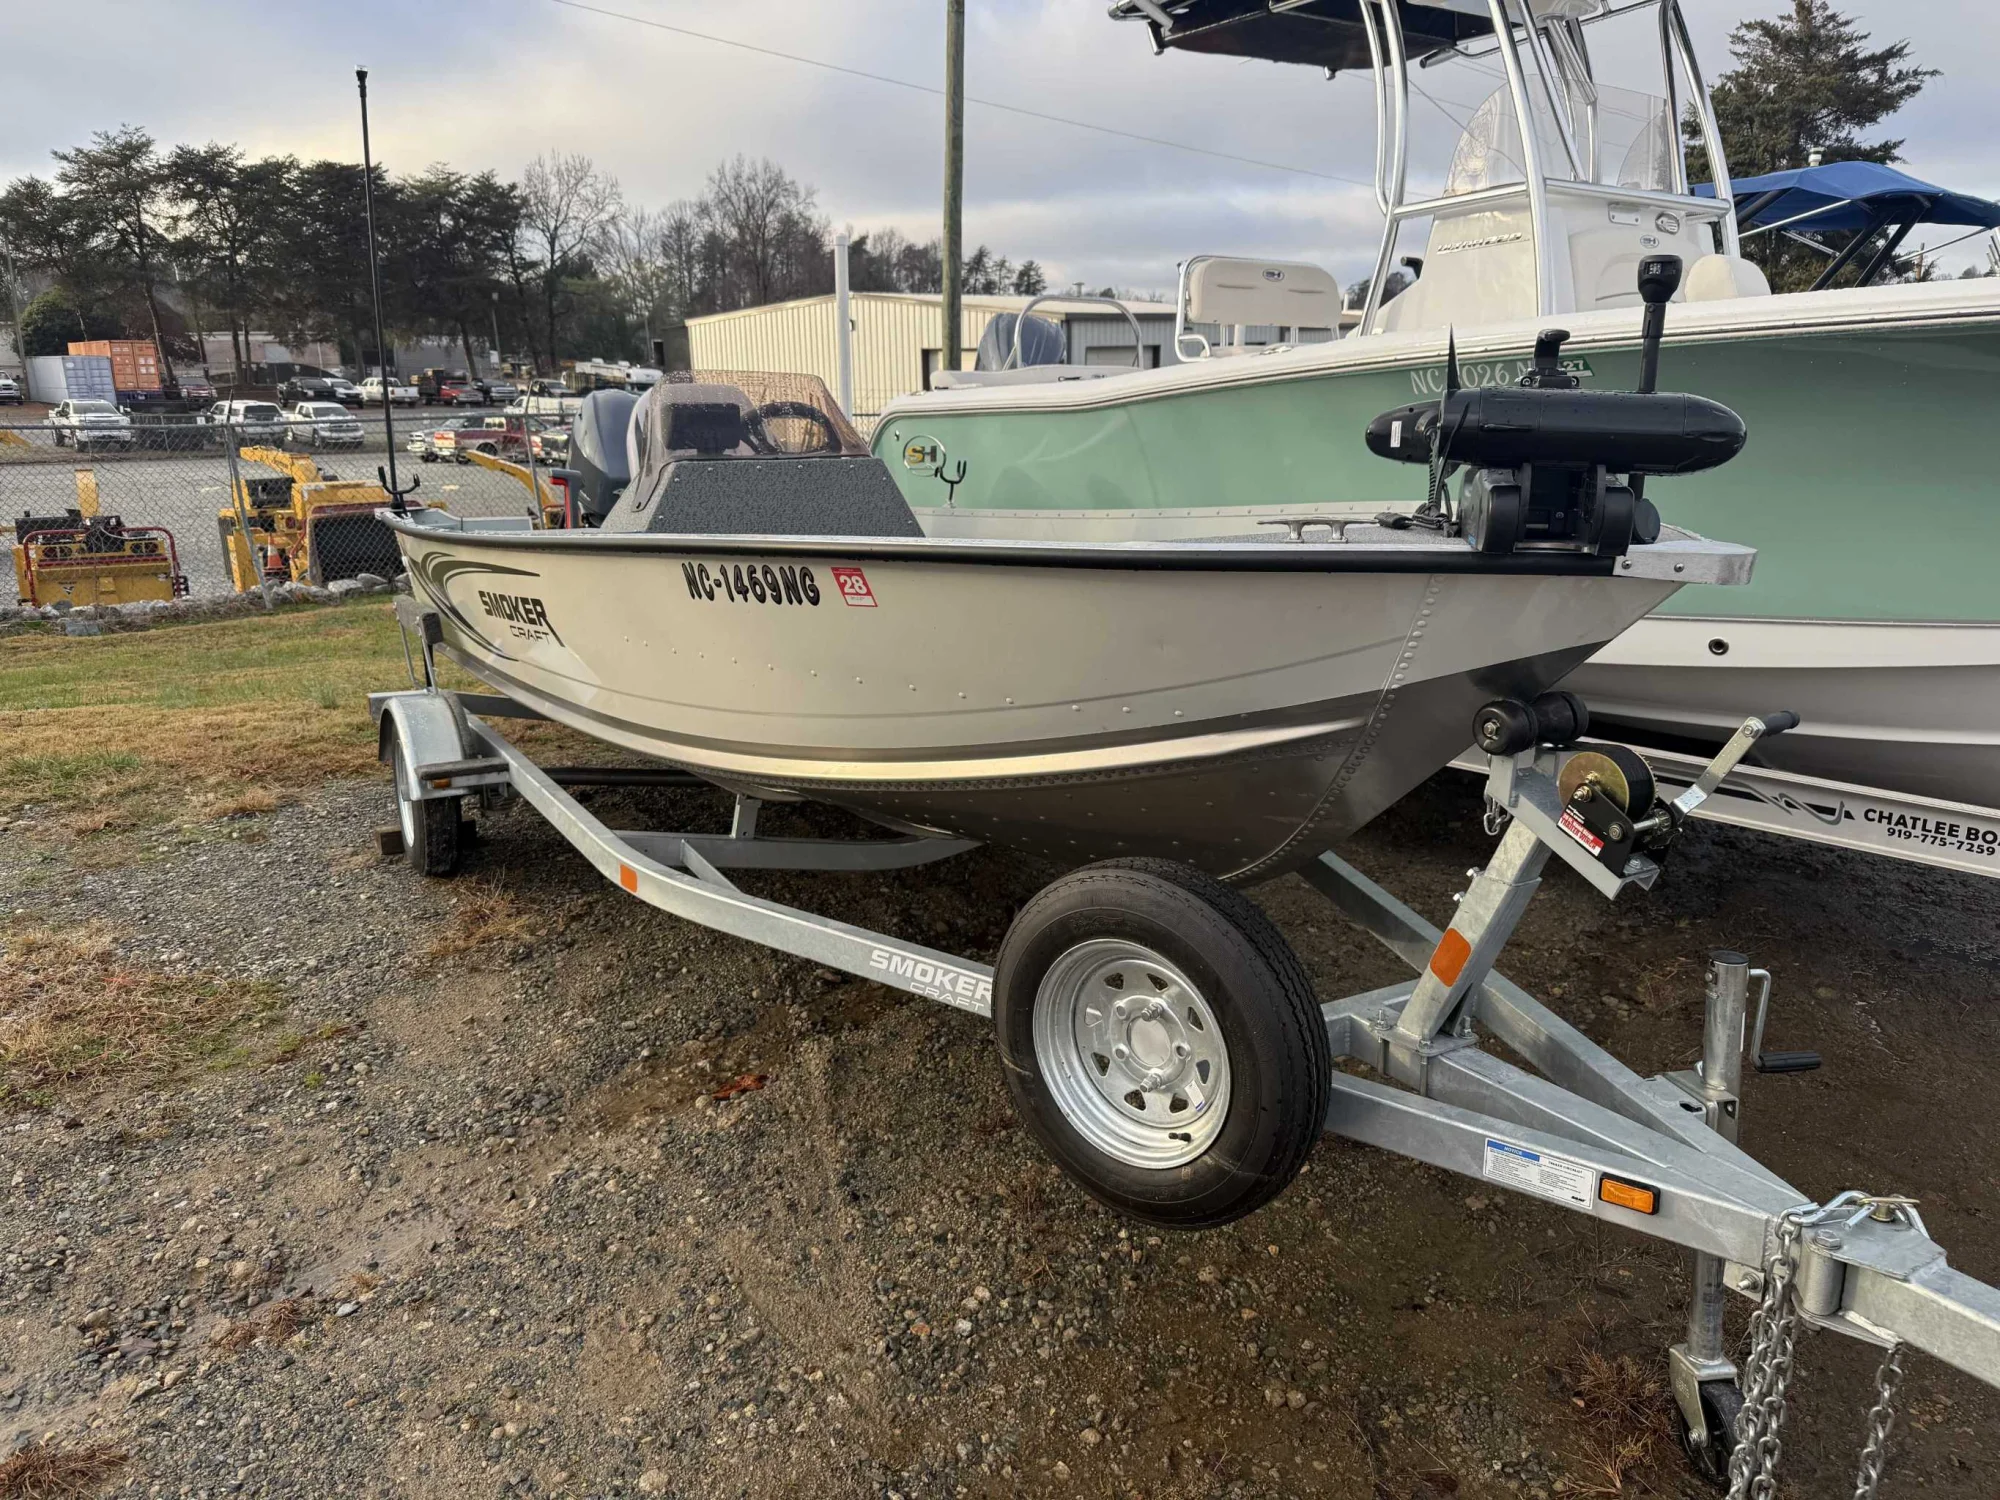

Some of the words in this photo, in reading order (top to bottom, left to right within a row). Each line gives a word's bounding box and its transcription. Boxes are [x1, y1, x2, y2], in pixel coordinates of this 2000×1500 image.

[1410, 368, 1444, 395] NC
[1449, 362, 1510, 388] 026
[1563, 360, 1585, 371] 27
[906, 445, 937, 465] SH
[682, 561, 820, 606] NC-1469NG
[839, 575, 868, 594] 28
[478, 590, 565, 648] SMOKER
[509, 625, 550, 645] CRAFT
[1864, 808, 1960, 838] CHATLEE
[1965, 826, 2000, 846] BO
[1887, 827, 1996, 856] 919-775-7259
[869, 949, 993, 1004] SMOKER
[909, 982, 985, 1011] CRAFT
[1503, 1145, 1523, 1156] NOTICE
